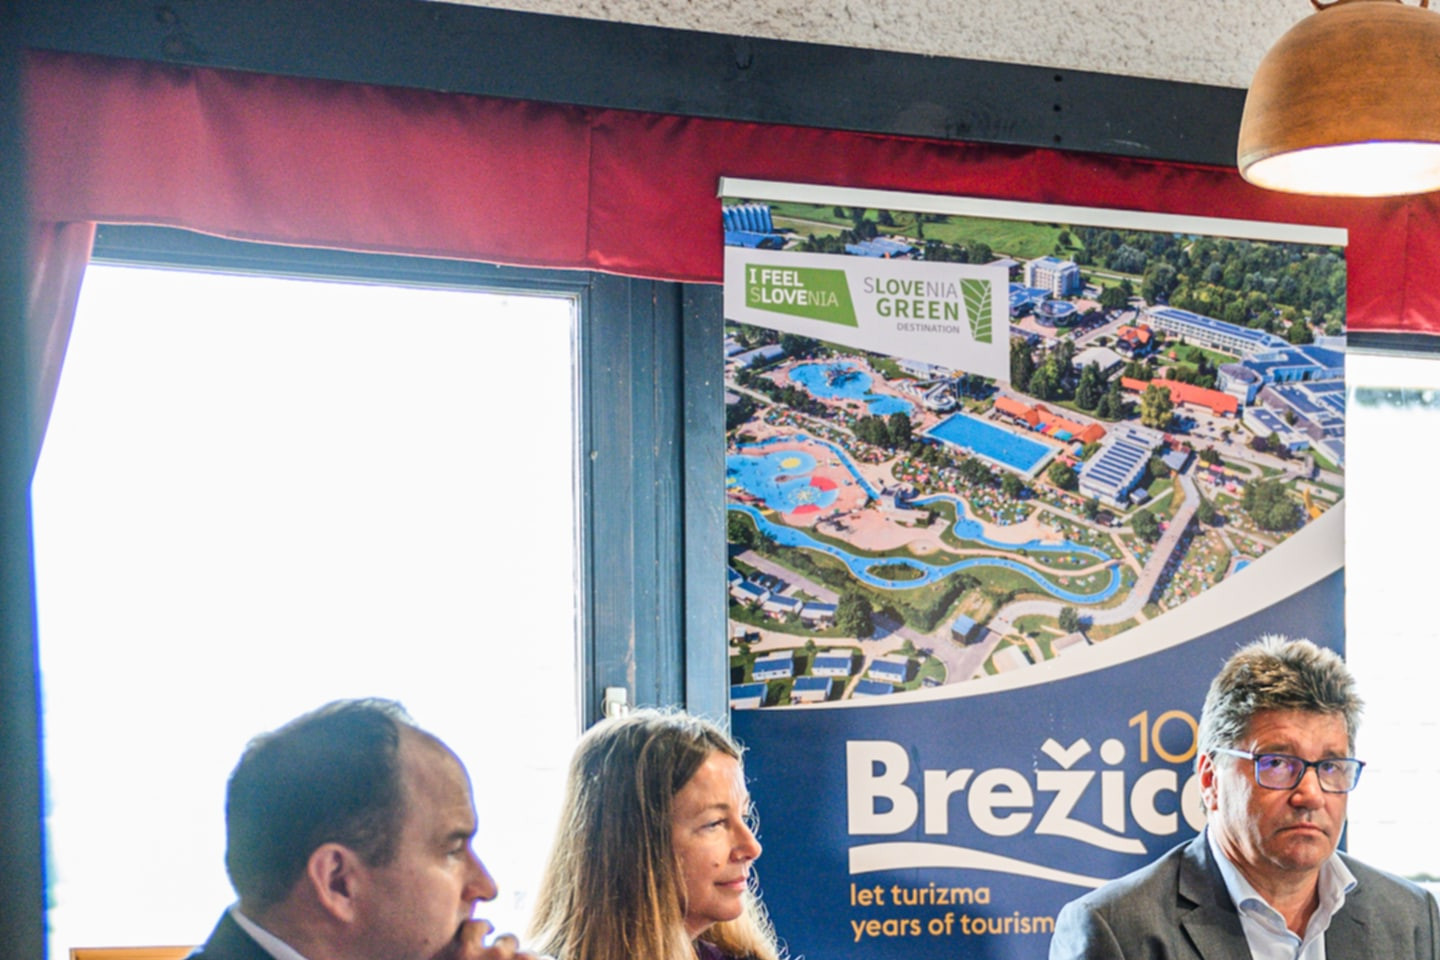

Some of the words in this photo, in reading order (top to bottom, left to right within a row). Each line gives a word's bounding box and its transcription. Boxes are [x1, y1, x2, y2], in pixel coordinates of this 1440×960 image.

[749, 268, 757, 284] I
[761, 269, 804, 287] FEEL
[863, 276, 958, 299] SLOVENIA
[750, 286, 839, 308] SLOVENIA
[876, 297, 959, 321] GREEN
[897, 322, 960, 335] DESTINATION
[850, 882, 885, 906] let
[890, 882, 991, 905] turizma
[850, 917, 921, 943] years
[928, 912, 955, 936] of
[960, 911, 1055, 935] tourism
